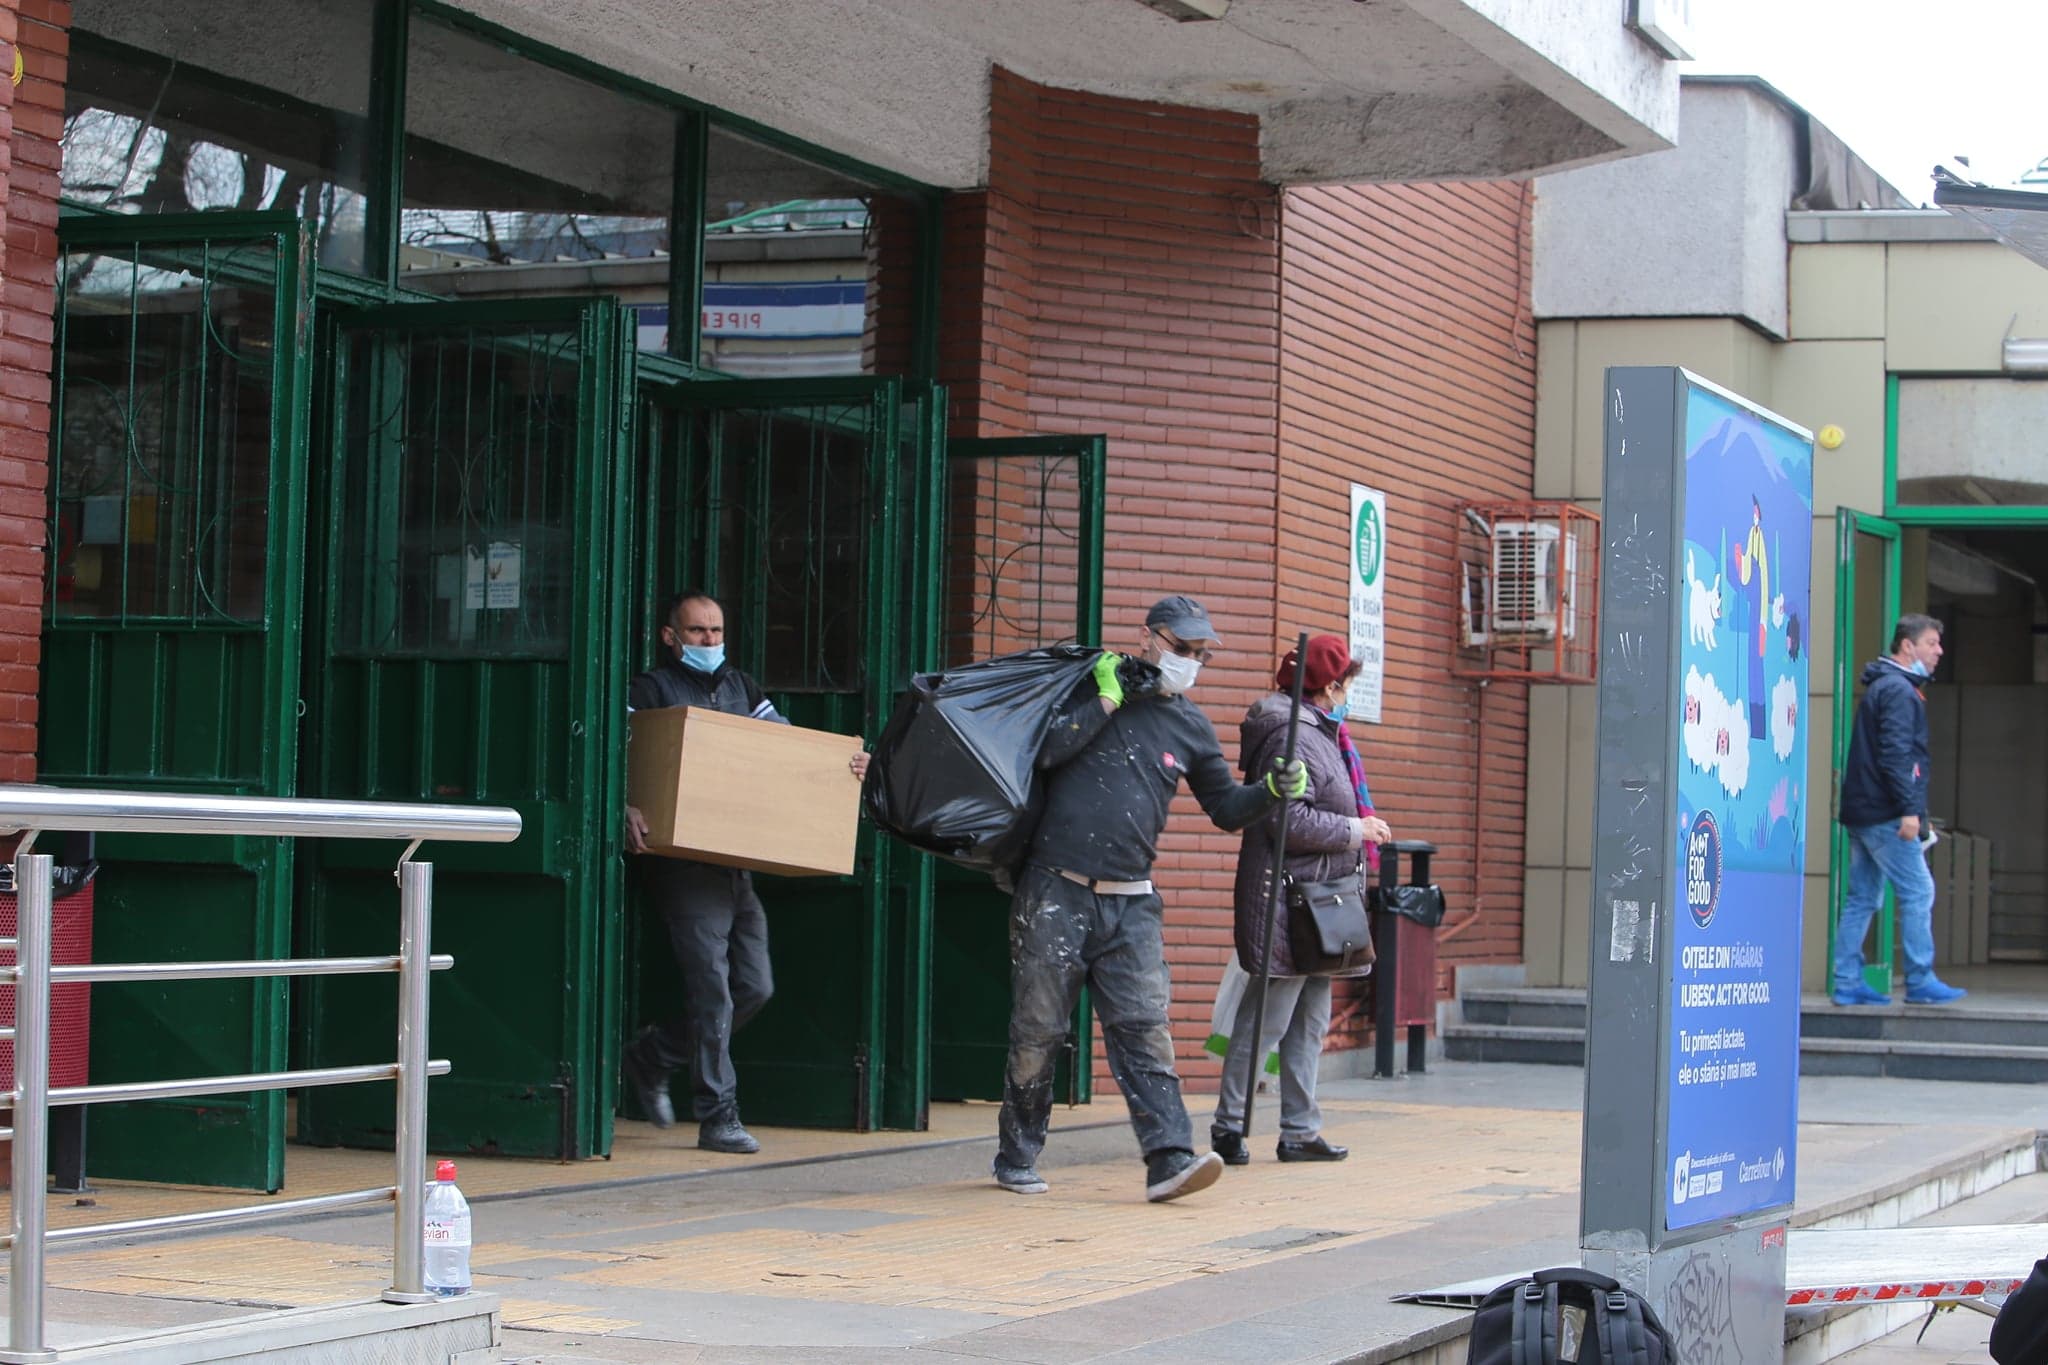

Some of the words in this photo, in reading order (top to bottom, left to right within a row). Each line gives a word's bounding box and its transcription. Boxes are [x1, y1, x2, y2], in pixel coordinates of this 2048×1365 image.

[1689, 856, 1705, 881] FOR
[1688, 881, 1711, 905] GOOD
[1715, 946, 1730, 969] DIN
[1681, 983, 1715, 1007] IUBESC
[1715, 983, 1732, 1006] ACT
[1732, 982, 1748, 1005] FOR
[1748, 981, 1770, 1003] GOOD.
[1680, 1030, 1691, 1052] Tu
[1723, 1027, 1746, 1050] lactate,
[1679, 1063, 1691, 1085] ele
[1693, 1067, 1699, 1084] o
[1727, 1057, 1740, 1080] mai
[1739, 1156, 1772, 1184] Carrefour
[424, 1228, 449, 1239] evian
